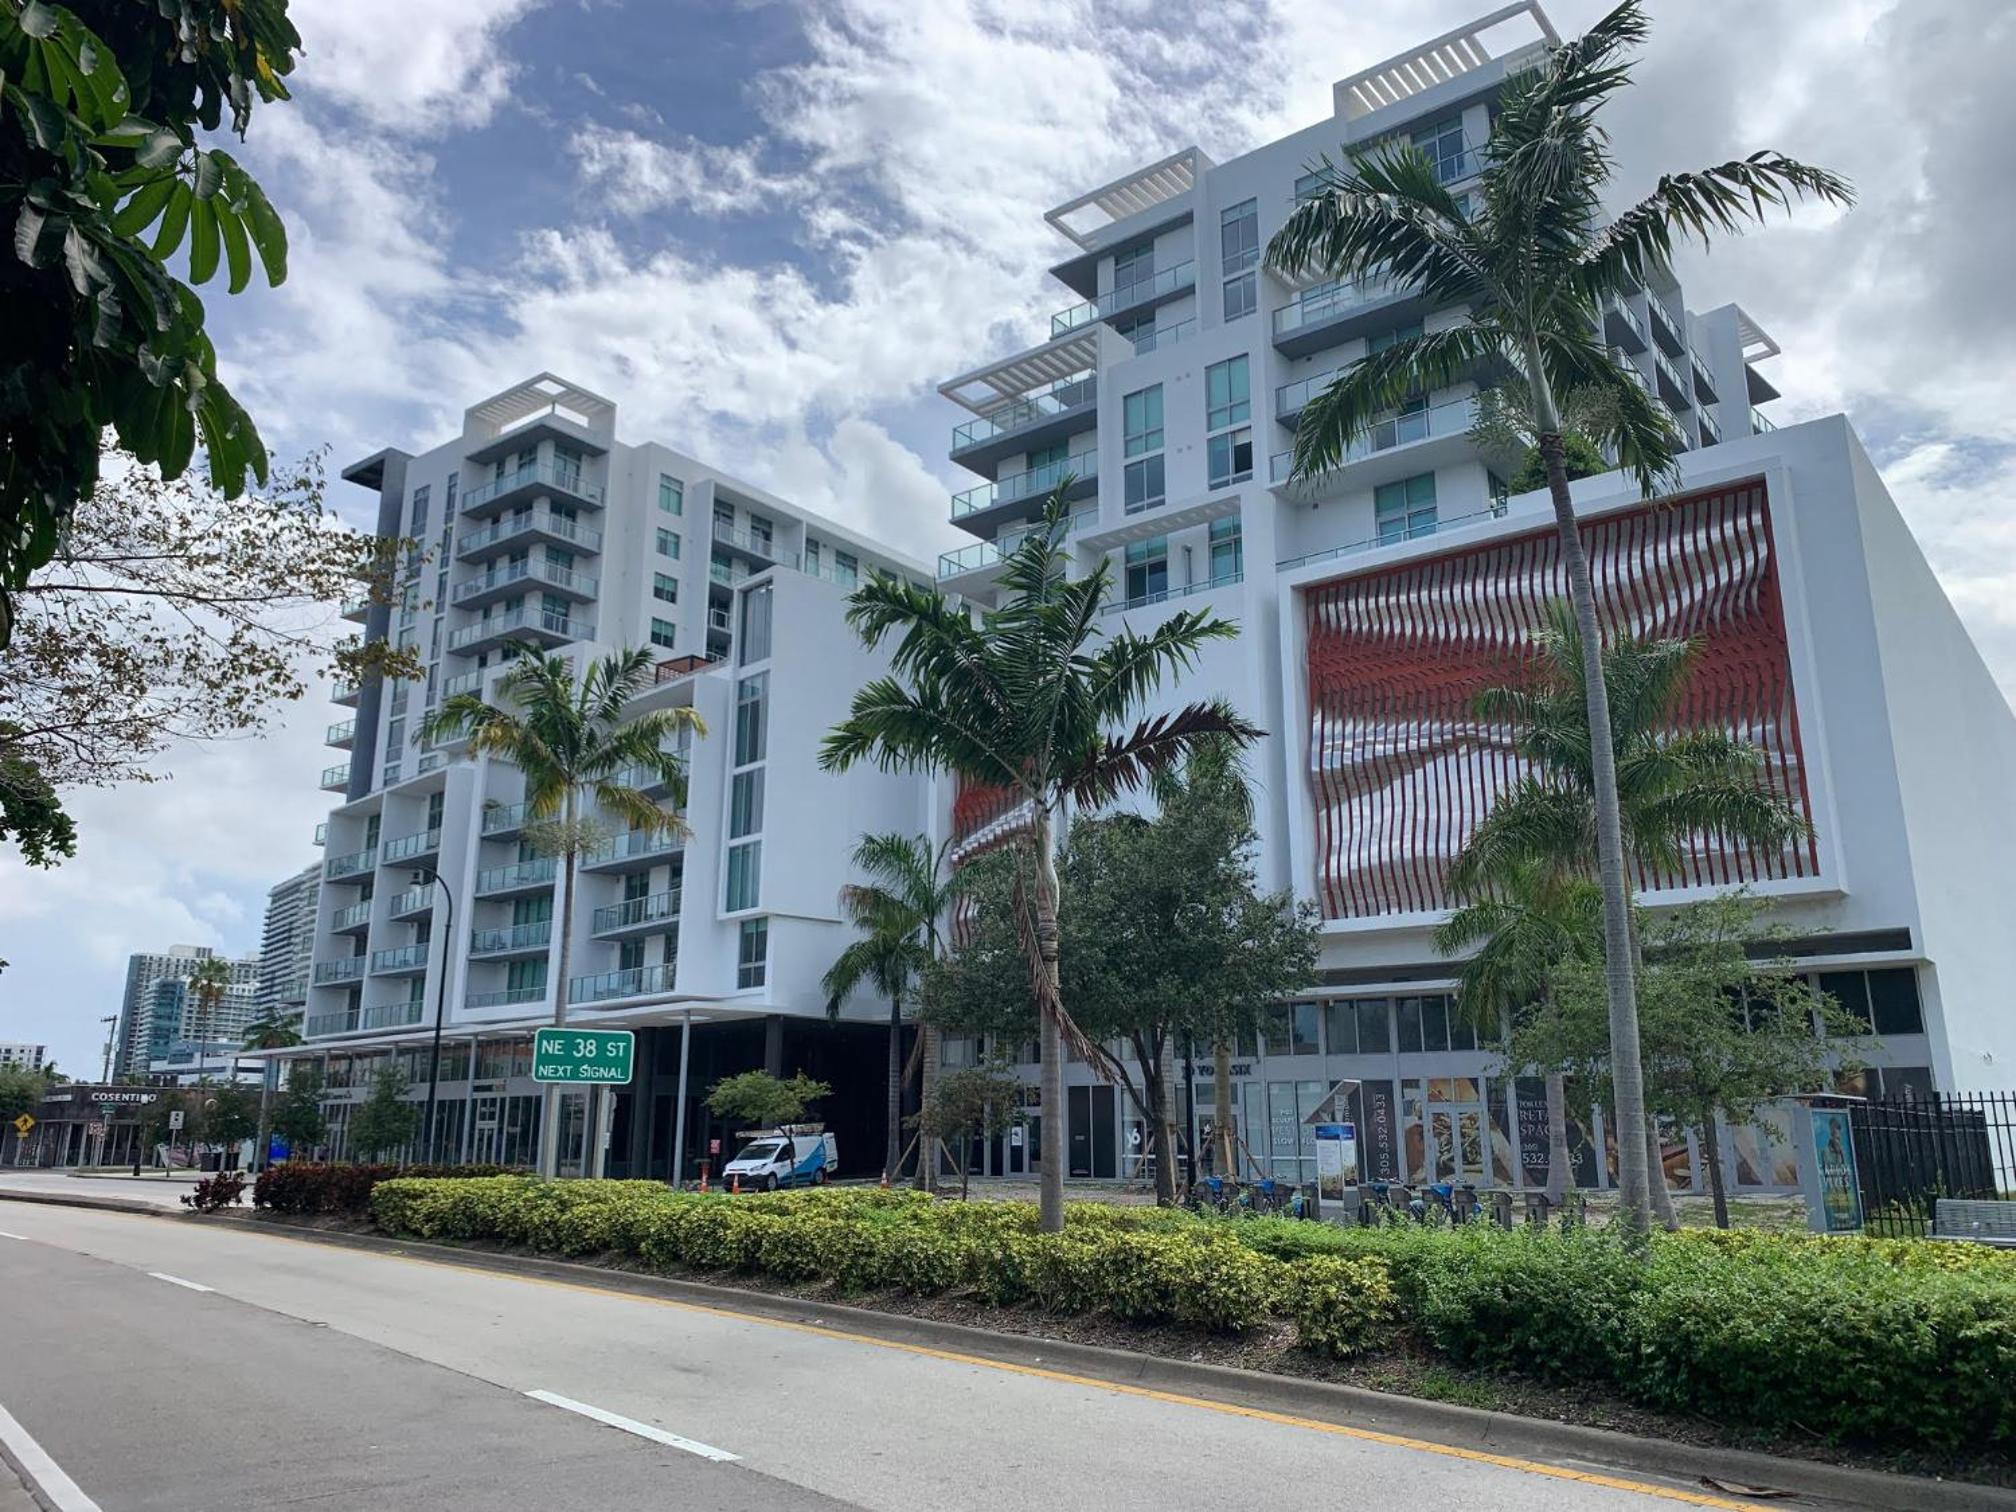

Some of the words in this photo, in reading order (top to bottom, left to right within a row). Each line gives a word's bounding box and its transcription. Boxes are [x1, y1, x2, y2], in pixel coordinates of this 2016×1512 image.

[541, 1039, 565, 1055] NE
[573, 1038, 597, 1058] 38
[606, 1042, 628, 1057] ST
[538, 1064, 573, 1078] NEXT
[578, 1065, 626, 1079] SIGNAL
[1196, 1064, 1252, 1076] YOSIX
[91, 1092, 158, 1102] COSENTIO
[1519, 1123, 1551, 1136] SPAC
[1522, 1152, 1584, 1165] 532.33
